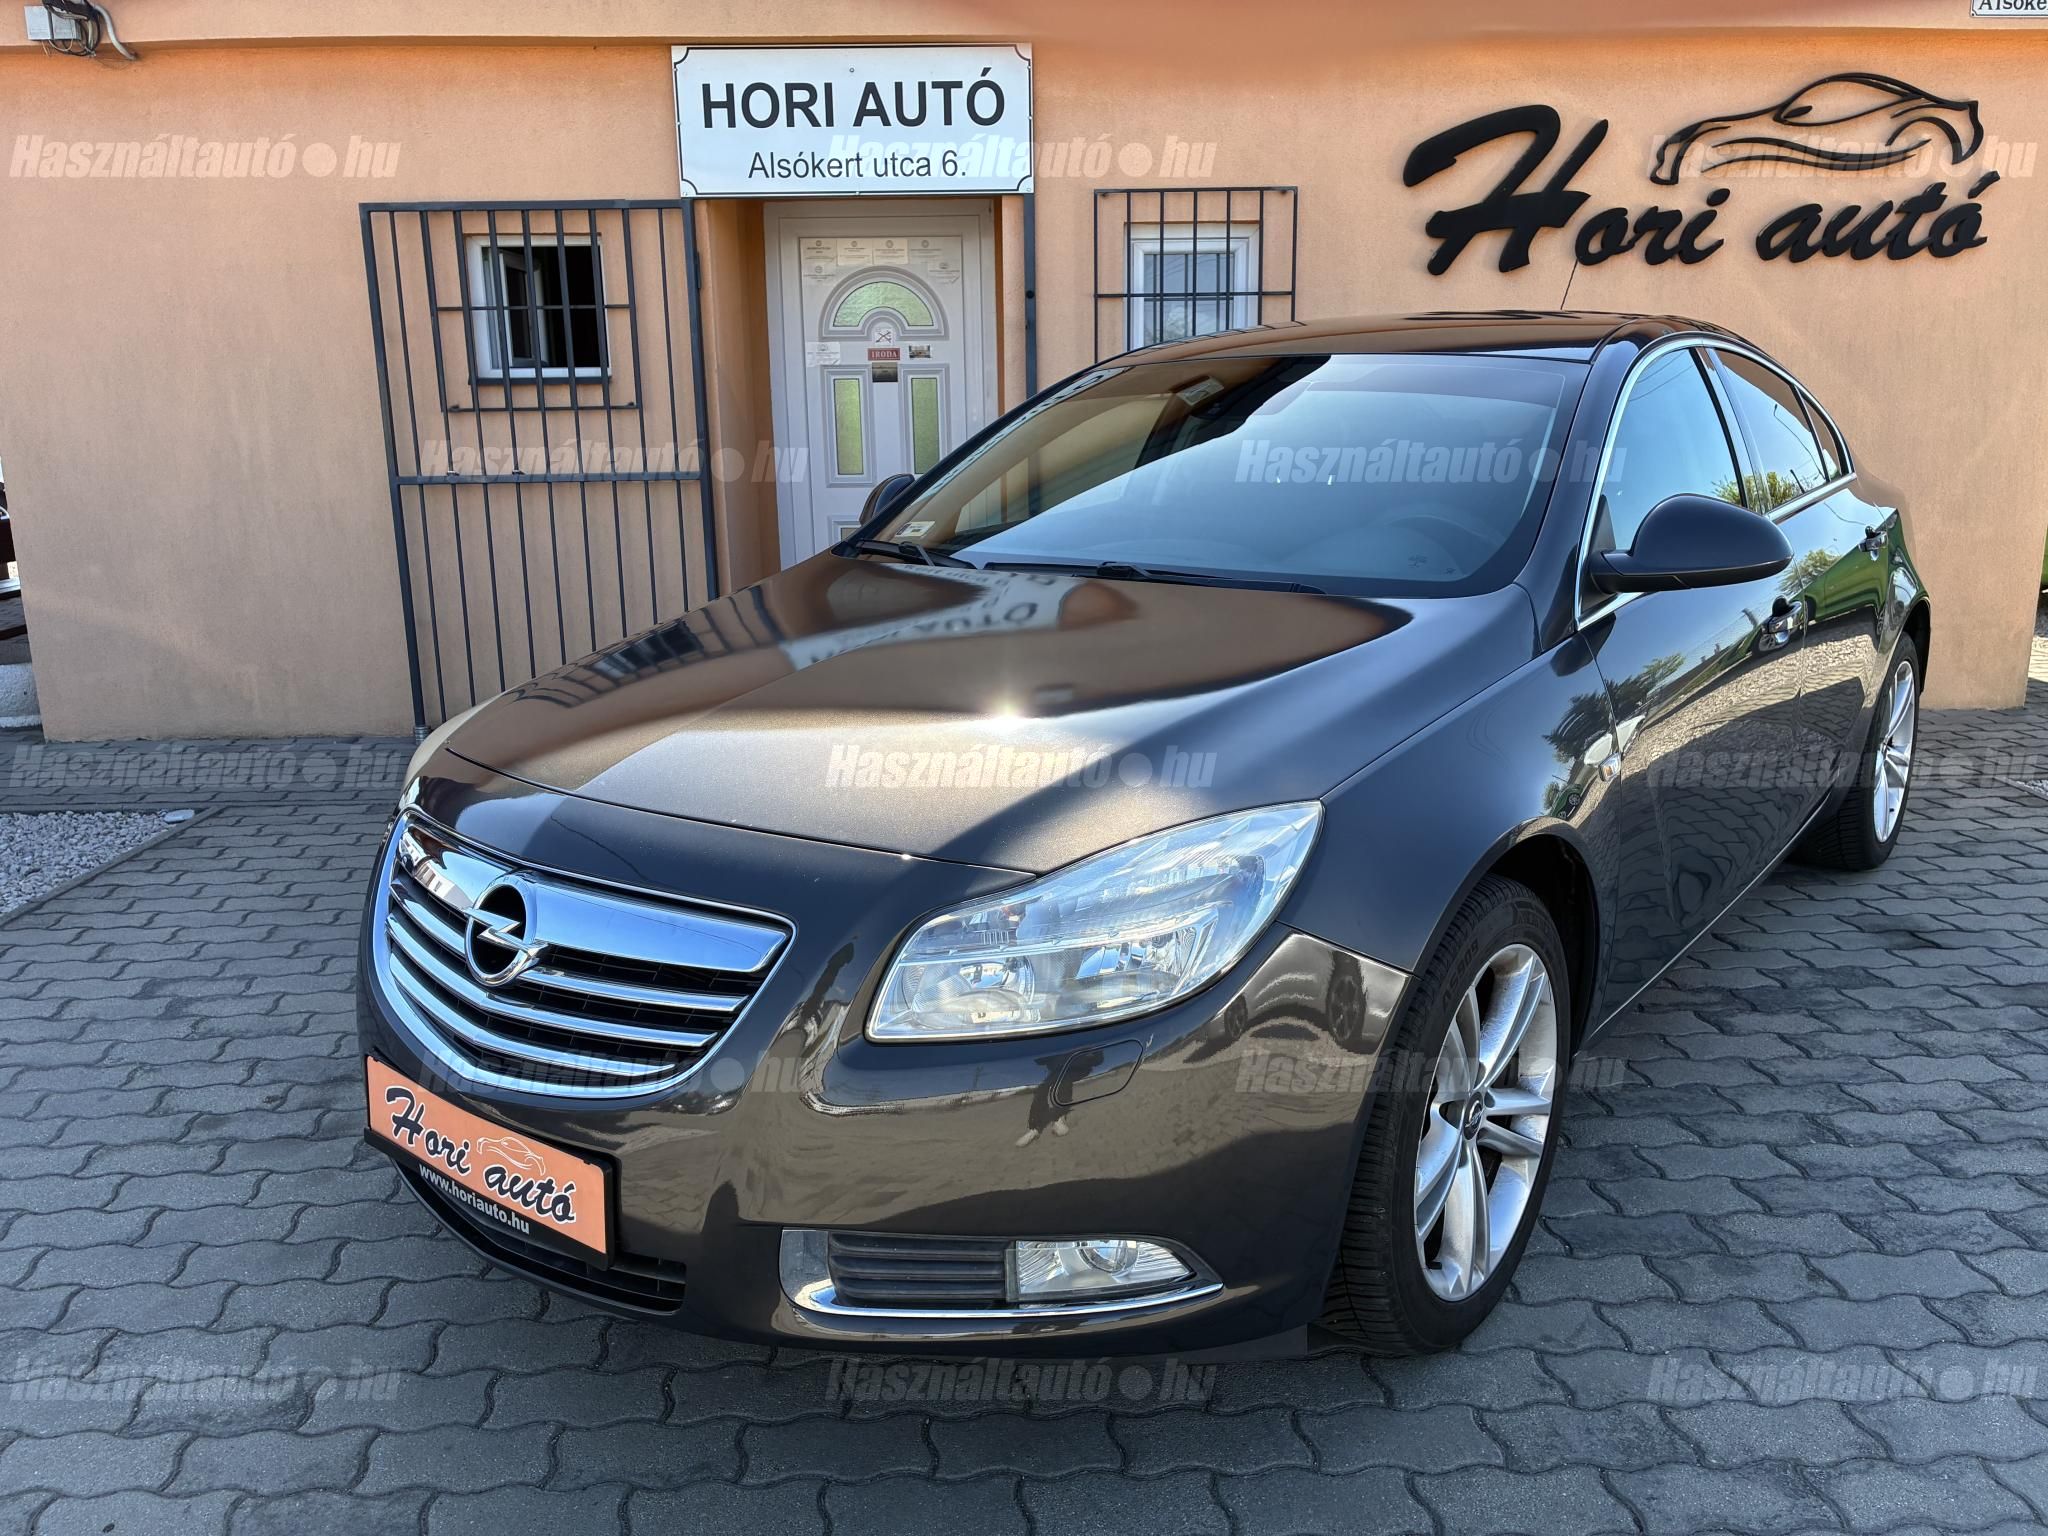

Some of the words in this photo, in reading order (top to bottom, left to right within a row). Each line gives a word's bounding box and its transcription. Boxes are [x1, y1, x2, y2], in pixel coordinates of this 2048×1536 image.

[702, 82, 835, 129] HORI
[852, 67, 1006, 128] AUTÓ
[748, 149, 863, 179] Alsókert
[873, 152, 930, 177] utca
[942, 149, 967, 176] 6.
[1403, 104, 1731, 276] Hori
[1756, 170, 2001, 263] autó
[871, 349, 898, 359] IRODA
[384, 1085, 472, 1176] Hori
[483, 1163, 577, 1225] autó
[418, 1163, 531, 1235] www.horiauto.hu
